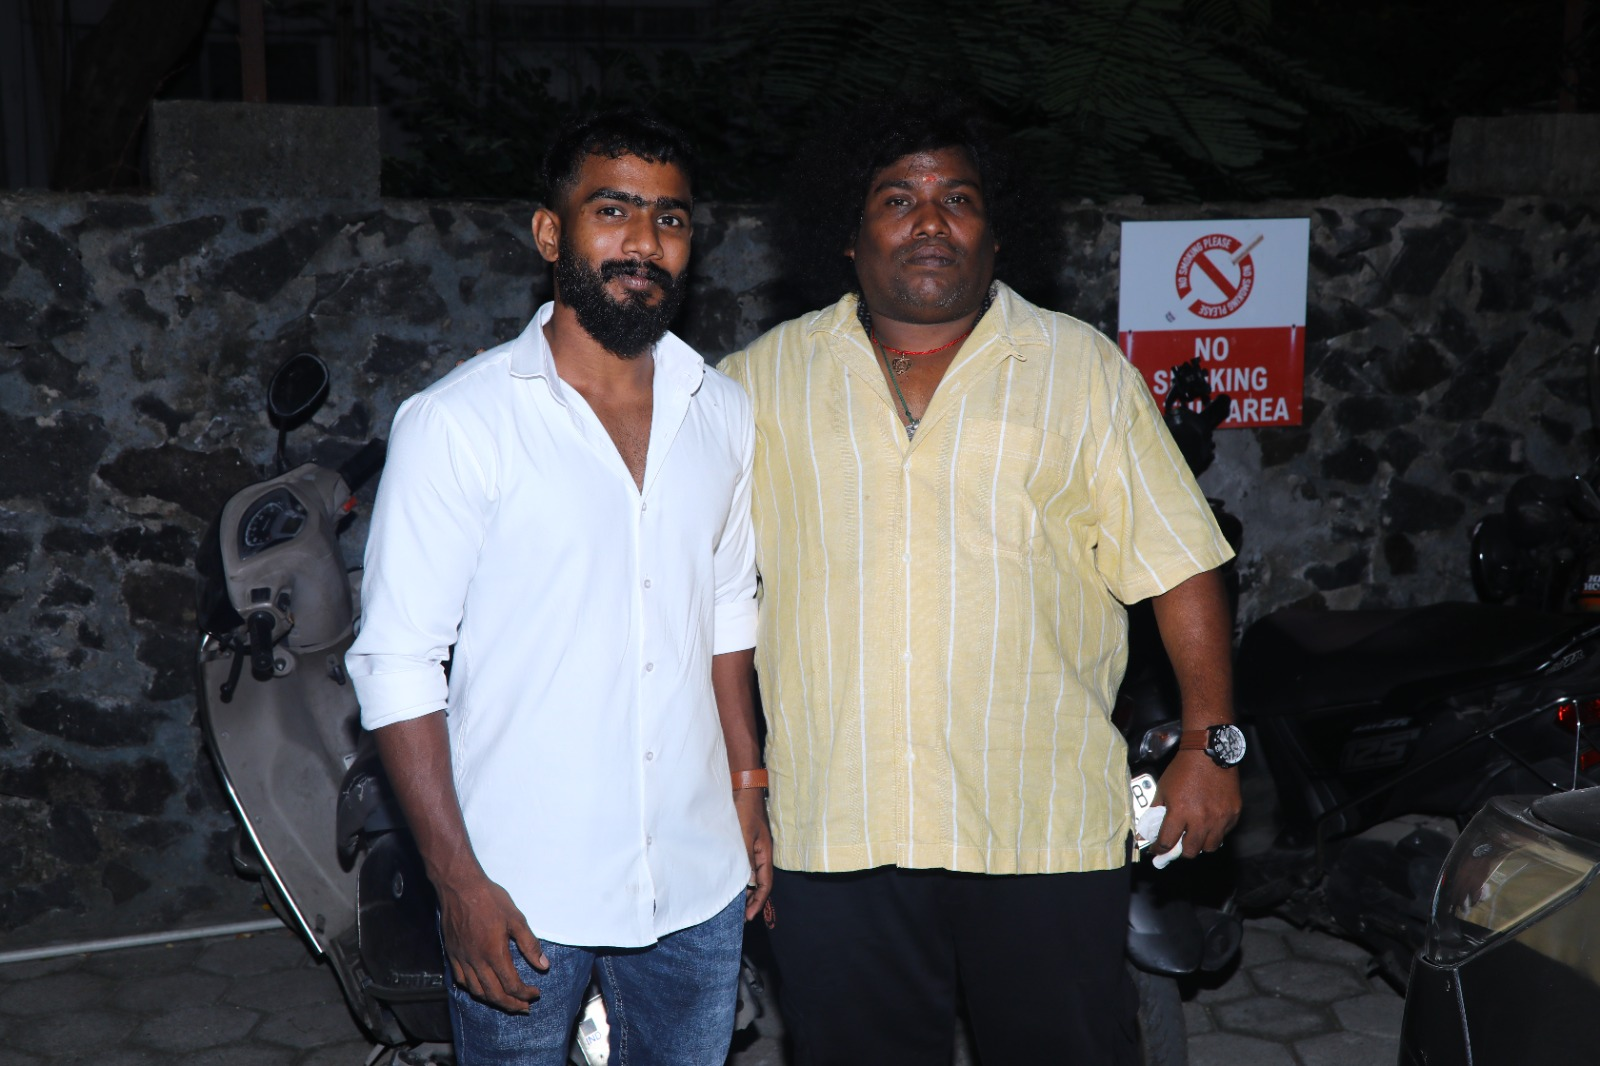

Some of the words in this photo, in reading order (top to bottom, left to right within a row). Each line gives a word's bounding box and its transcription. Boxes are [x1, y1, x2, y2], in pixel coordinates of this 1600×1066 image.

[1203, 236, 1232, 249] PLEASE
[1178, 242, 1203, 276] SMOKING
[1242, 264, 1252, 277] NO
[1178, 277, 1188, 289] NO
[1227, 278, 1252, 311] SMOKING
[1198, 305, 1228, 317] PLEASE
[1195, 336, 1229, 361] NO
[1153, 366, 1268, 395] SKING
[1226, 397, 1289, 423] AREA
[1345, 735, 1409, 769] 125
[586, 1031, 602, 1046] IND
